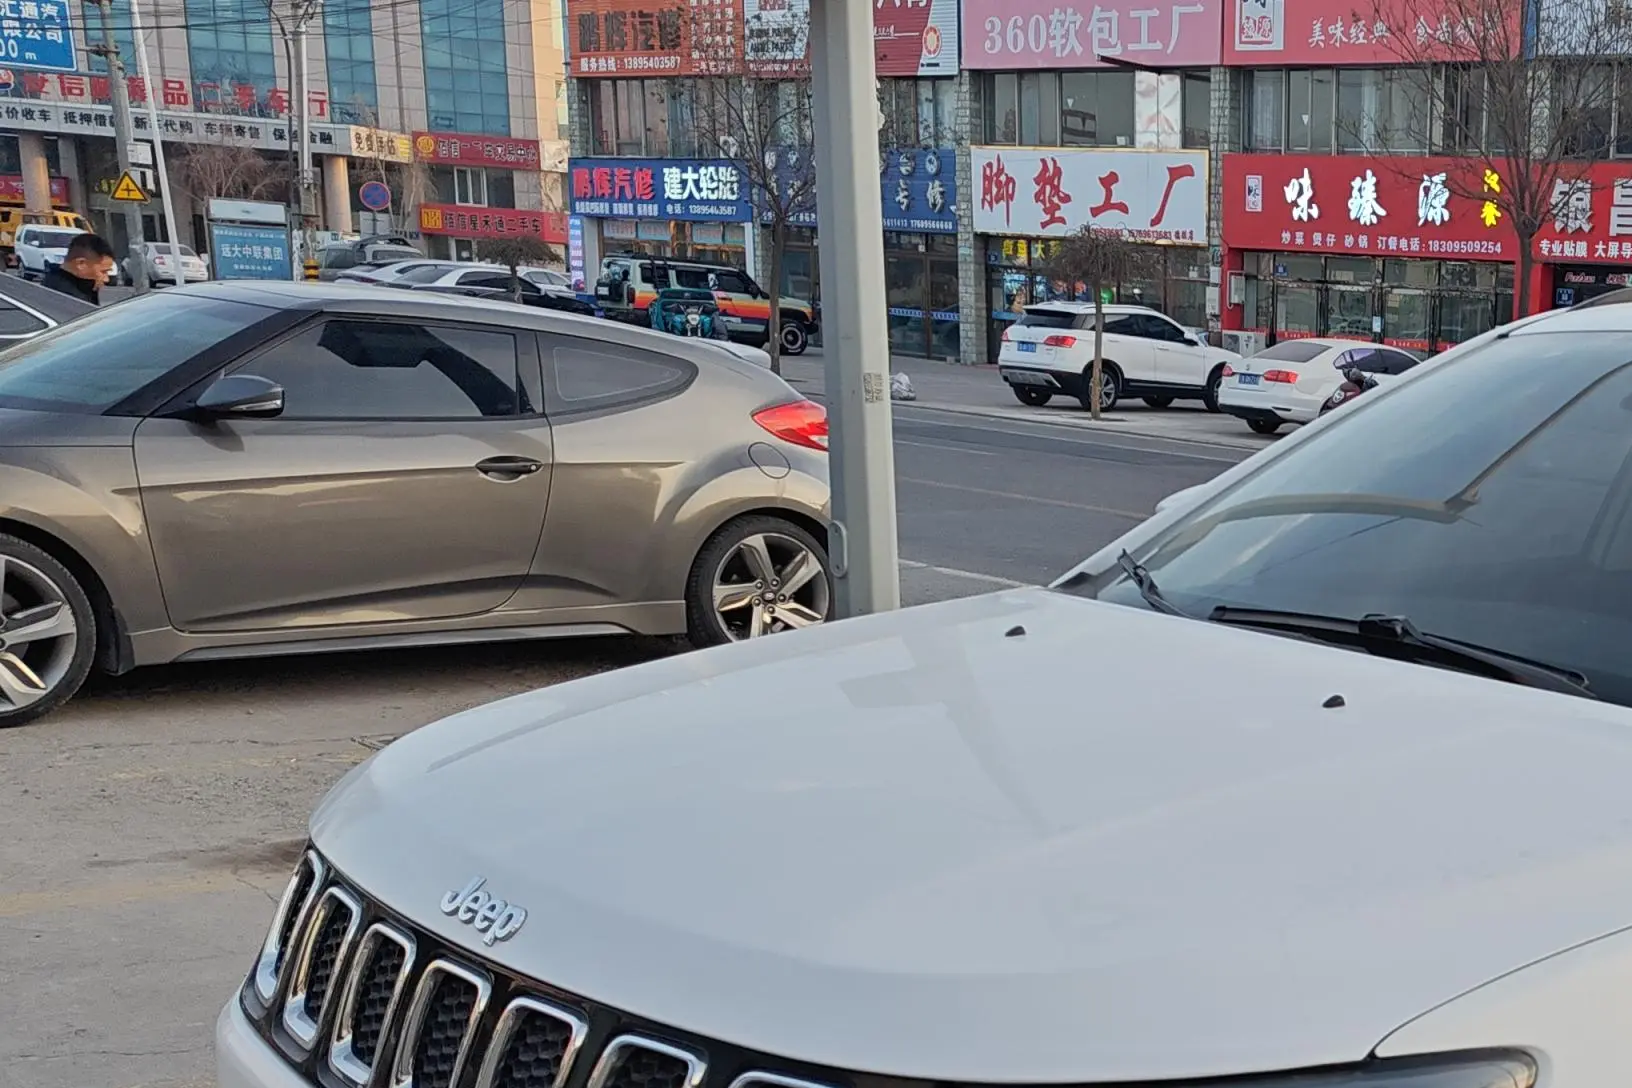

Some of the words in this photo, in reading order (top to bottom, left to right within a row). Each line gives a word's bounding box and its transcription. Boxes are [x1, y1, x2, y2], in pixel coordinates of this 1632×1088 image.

[984, 4, 1204, 57] 360软包工厂
[1308, 17, 1390, 48] 美味经典
[24, 51, 37, 61] m
[64, 110, 116, 127] 抵押借
[663, 166, 740, 201] 建大轮胎
[981, 153, 1195, 230] 脚垫工厂
[1539, 239, 1588, 259] 专业贴膜
[439, 875, 528, 946] Jeep
